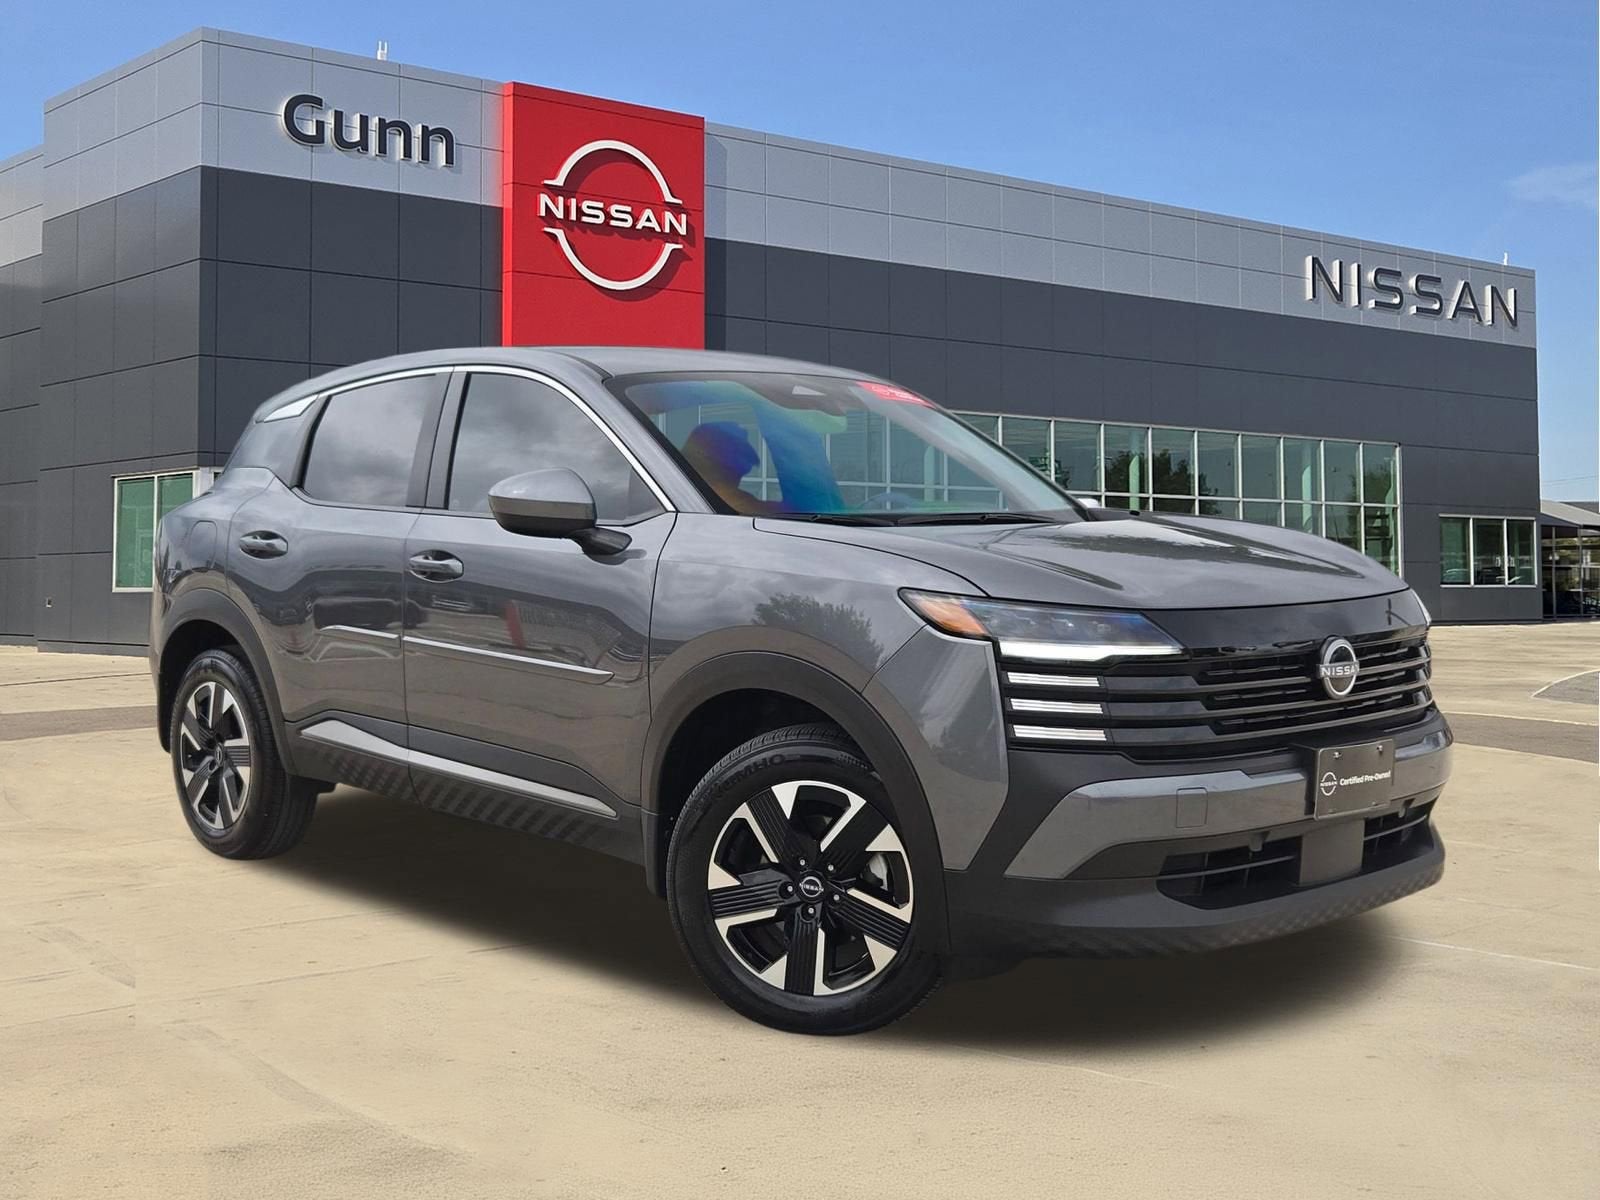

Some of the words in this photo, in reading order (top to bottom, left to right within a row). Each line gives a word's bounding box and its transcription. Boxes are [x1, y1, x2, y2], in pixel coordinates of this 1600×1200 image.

[282, 93, 456, 168] Gunn
[537, 192, 688, 237] NISSAN
[1305, 255, 1518, 328] NISSAN
[1320, 664, 1360, 677] NISSAN
[1339, 776, 1364, 786] Certified
[1364, 769, 1391, 782] Pre-Owned
